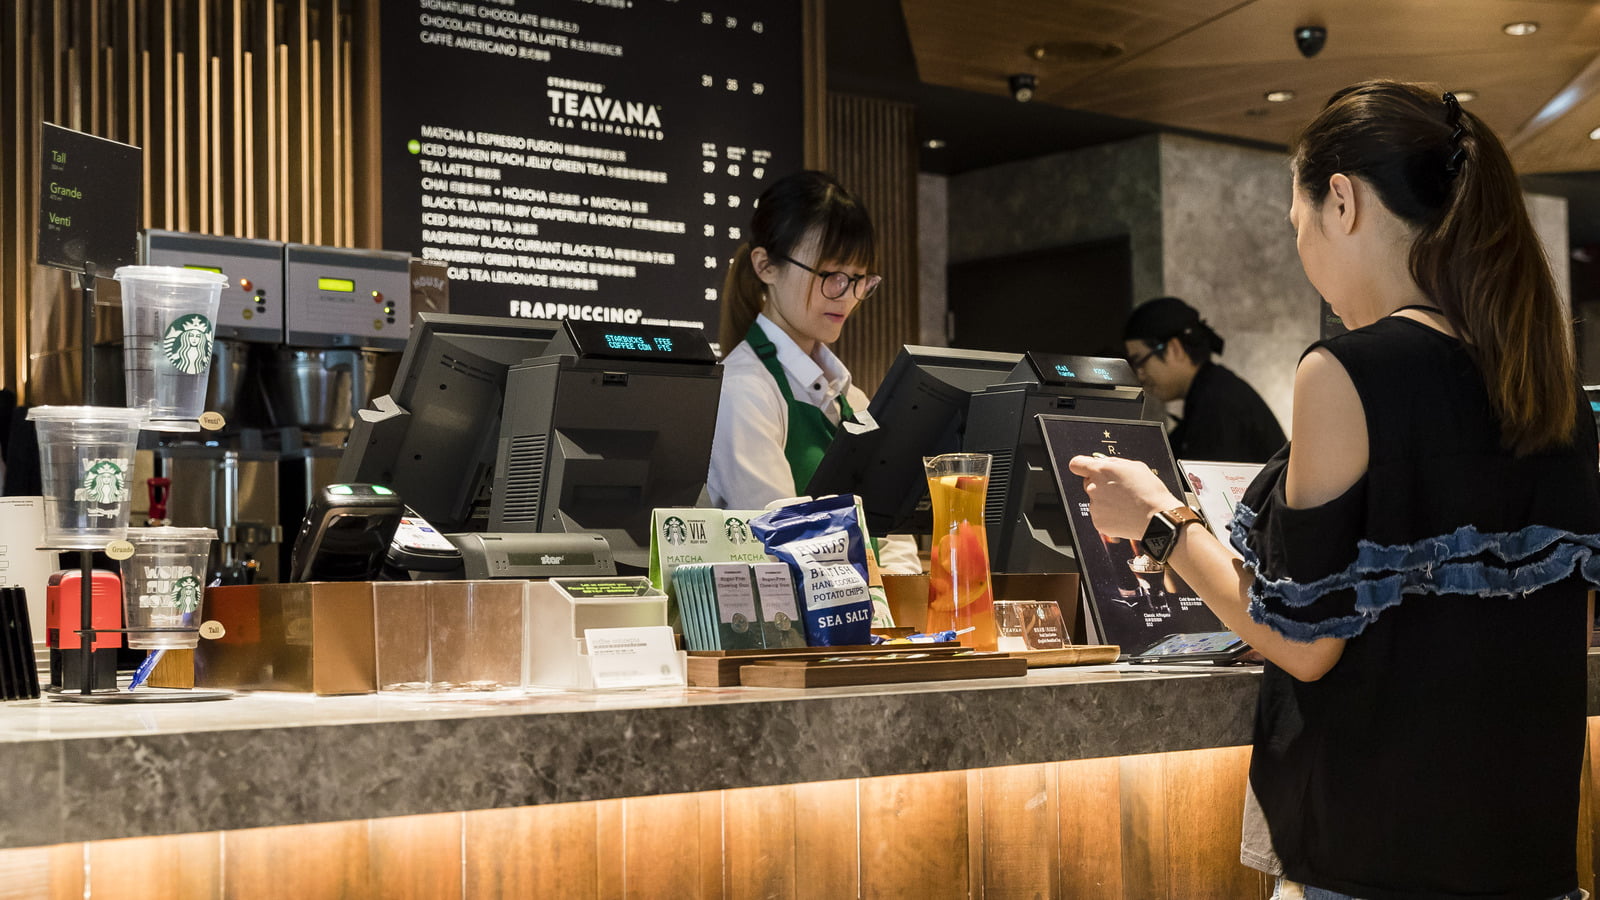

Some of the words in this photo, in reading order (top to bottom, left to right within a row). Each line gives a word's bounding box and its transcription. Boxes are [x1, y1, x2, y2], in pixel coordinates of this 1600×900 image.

[478, 6, 539, 27] CHOCOLATE
[420, 14, 483, 34] CHOCOLATE
[484, 23, 517, 40] BLACK
[518, 29, 538, 44] TEA
[538, 33, 568, 49] LATTE
[454, 36, 517, 57] AMERICANO
[547, 90, 661, 128] TEAVANA
[549, 116, 575, 129] TEA
[581, 121, 664, 141] REIMAGINED
[421, 125, 466, 142] MATCHA
[466, 130, 476, 144] &
[476, 132, 527, 150] ESPRESSO
[527, 138, 564, 154] FUSION
[52, 150, 67, 163] Tall
[421, 142, 447, 157] ICED
[447, 145, 490, 163] SHAKEN
[490, 150, 525, 166] PEACH
[525, 155, 552, 170] JELLY
[552, 158, 586, 174] GREEN
[586, 162, 606, 177] TEA
[419, 159, 441, 174] TEA
[441, 162, 474, 178] LATTE
[50, 182, 82, 199] Grande
[421, 177, 449, 191] CHAI
[590, 196, 631, 213] MATCHA
[49, 212, 71, 227] Venti
[421, 194, 456, 210] BLACK
[456, 198, 477, 212] TEA
[477, 200, 504, 215] WITH
[504, 203, 531, 218] RUBY
[531, 206, 589, 223] GRAPEFRUIT
[598, 213, 632, 228] HONEY
[421, 212, 448, 227] ICED
[448, 214, 491, 231] SHAKEN
[491, 218, 512, 233] TEA
[421, 229, 480, 247] RASPBERRY
[480, 235, 514, 250] BLACK
[514, 239, 561, 255] CURRANT
[561, 242, 595, 258] BLACK
[594, 246, 614, 260] TEA
[421, 247, 484, 265] STRAWBERRY
[484, 252, 518, 267] GREEN
[517, 255, 536, 269] TEA
[535, 257, 588, 274] LEMONADE
[469, 269, 491, 282] TEA
[491, 270, 549, 287] LEMONADE
[510, 300, 640, 324] FRAPPUCCINO
[605, 334, 645, 344] STARBUCKS
[608, 341, 636, 350] COFFEE
[690, 523, 706, 539] VIA
[541, 554, 561, 564] star
[666, 555, 704, 563] MATCHA
[730, 553, 765, 561] MATCHA
[813, 590, 844, 603] POTATO
[845, 586, 864, 597] CHIPS
[818, 614, 843, 629] SEA
[845, 609, 869, 624] SALT
[208, 626, 220, 634] Tall
